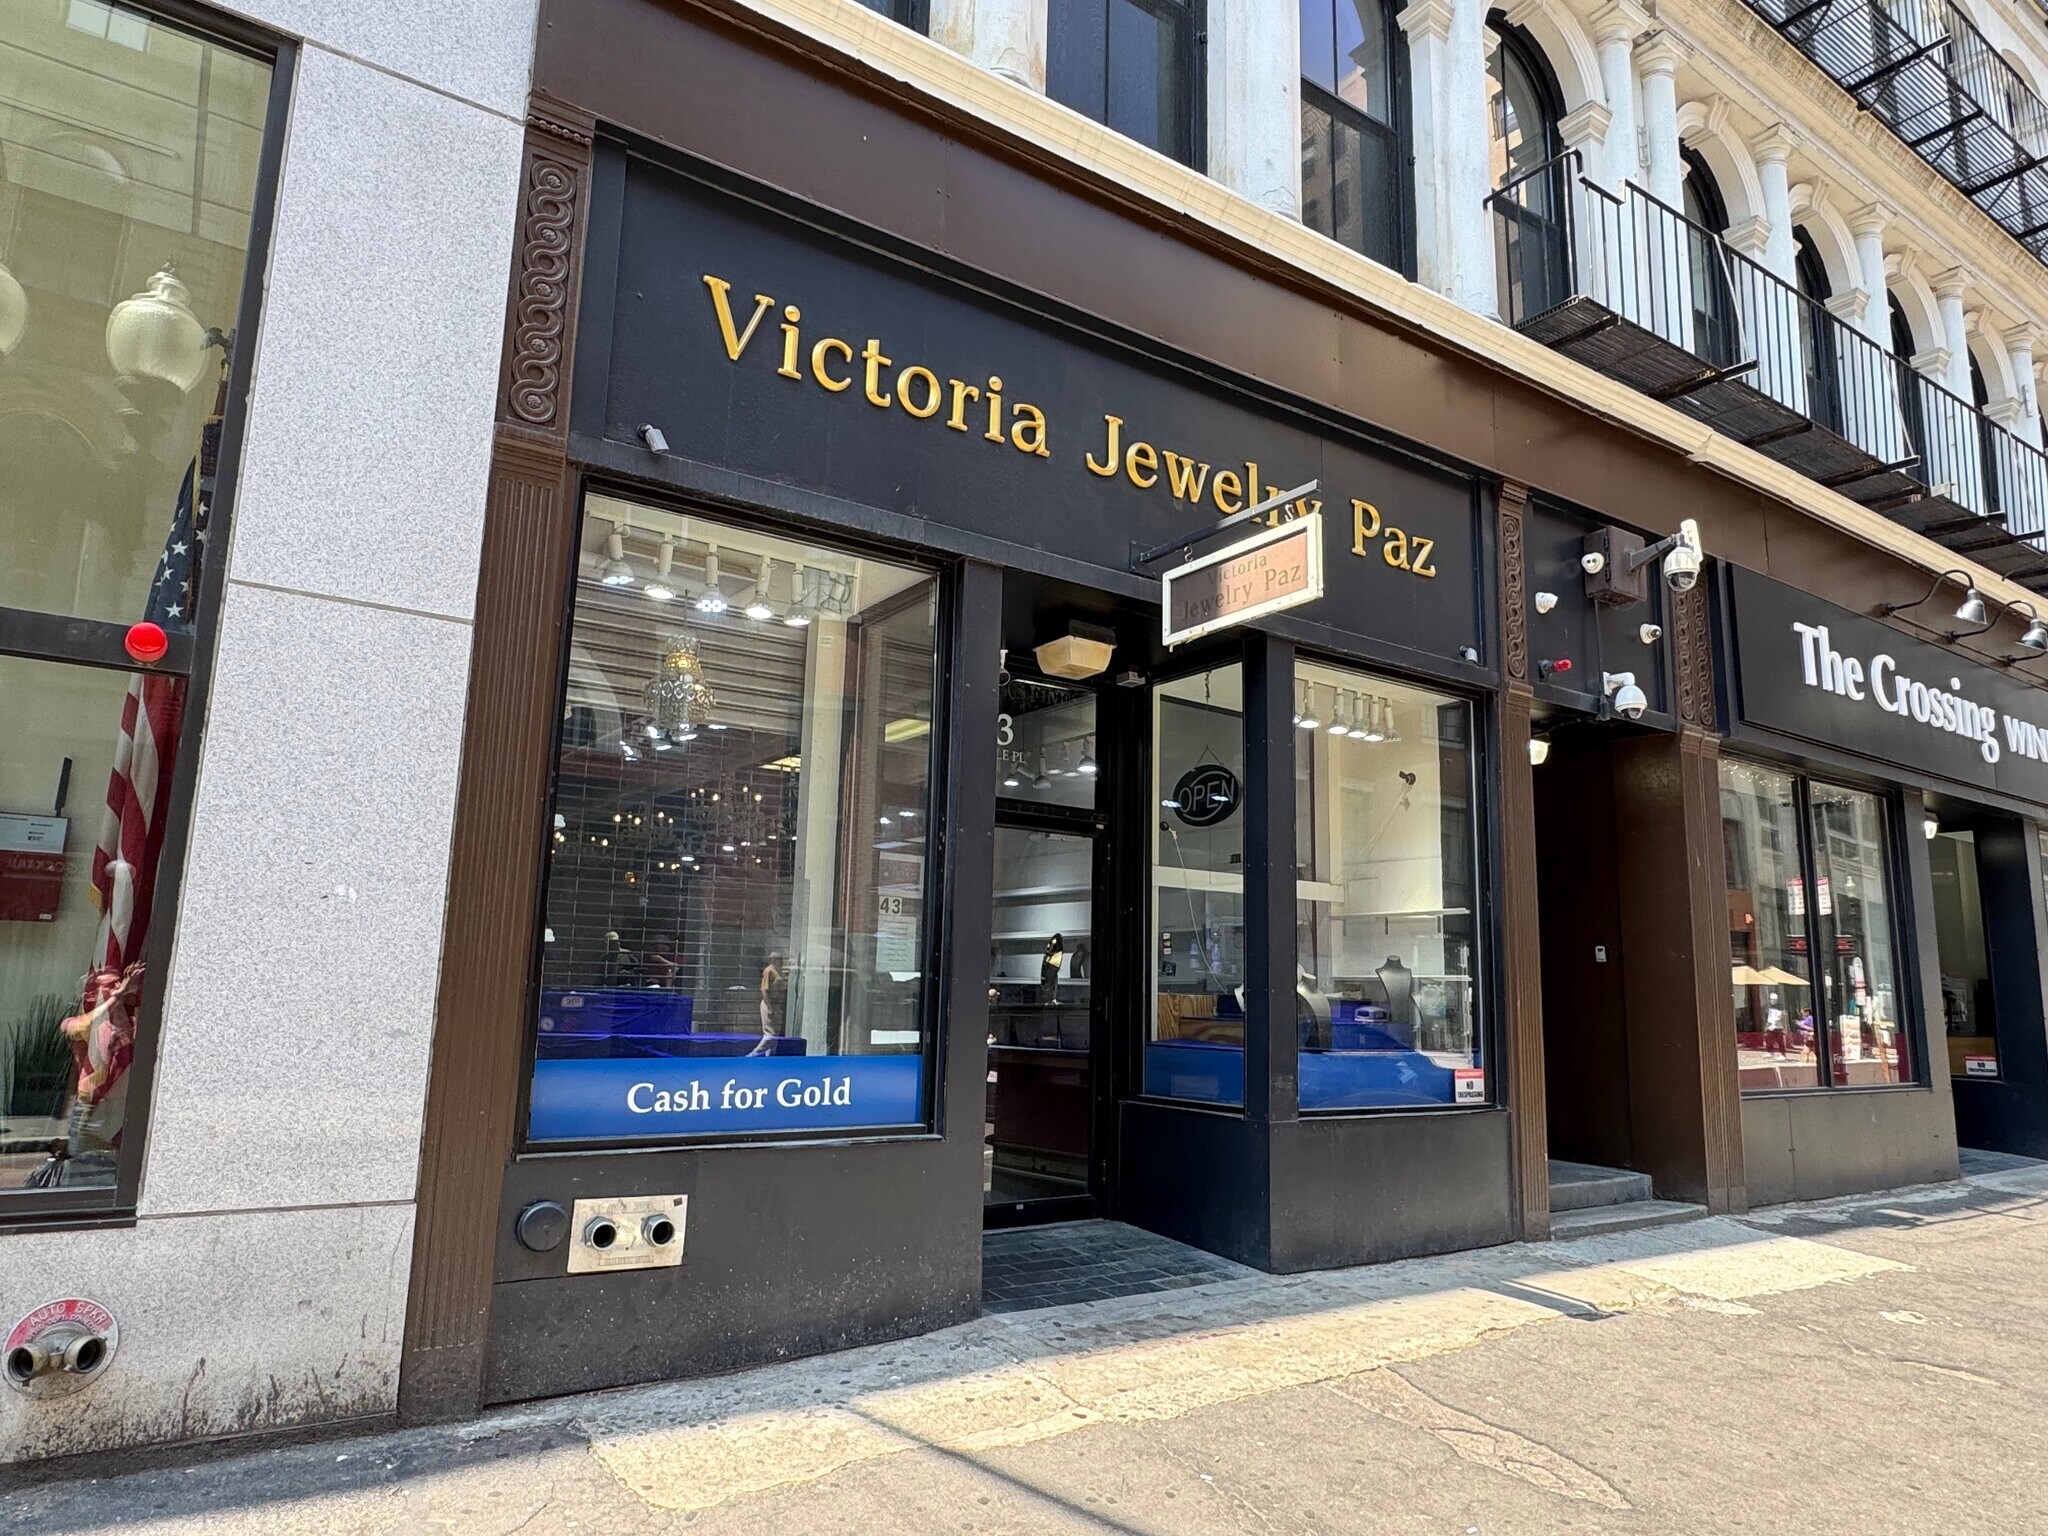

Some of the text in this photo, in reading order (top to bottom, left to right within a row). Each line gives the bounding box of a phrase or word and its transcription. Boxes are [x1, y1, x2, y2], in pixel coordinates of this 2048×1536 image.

[703, 275, 1050, 457] Victoria
[1351, 499, 1437, 577] Paz
[1207, 554, 1267, 584] Victoria
[1184, 565, 1301, 619] Jewelry Paz
[1793, 622, 1865, 700] The
[1871, 654, 2000, 763] Crossing
[1179, 778, 1235, 812] OPEN
[880, 897, 901, 915] 43
[627, 1077, 852, 1113] Cash for Gold
[29, 1303, 66, 1326] AUTO
[75, 1302, 107, 1326] SPKR
